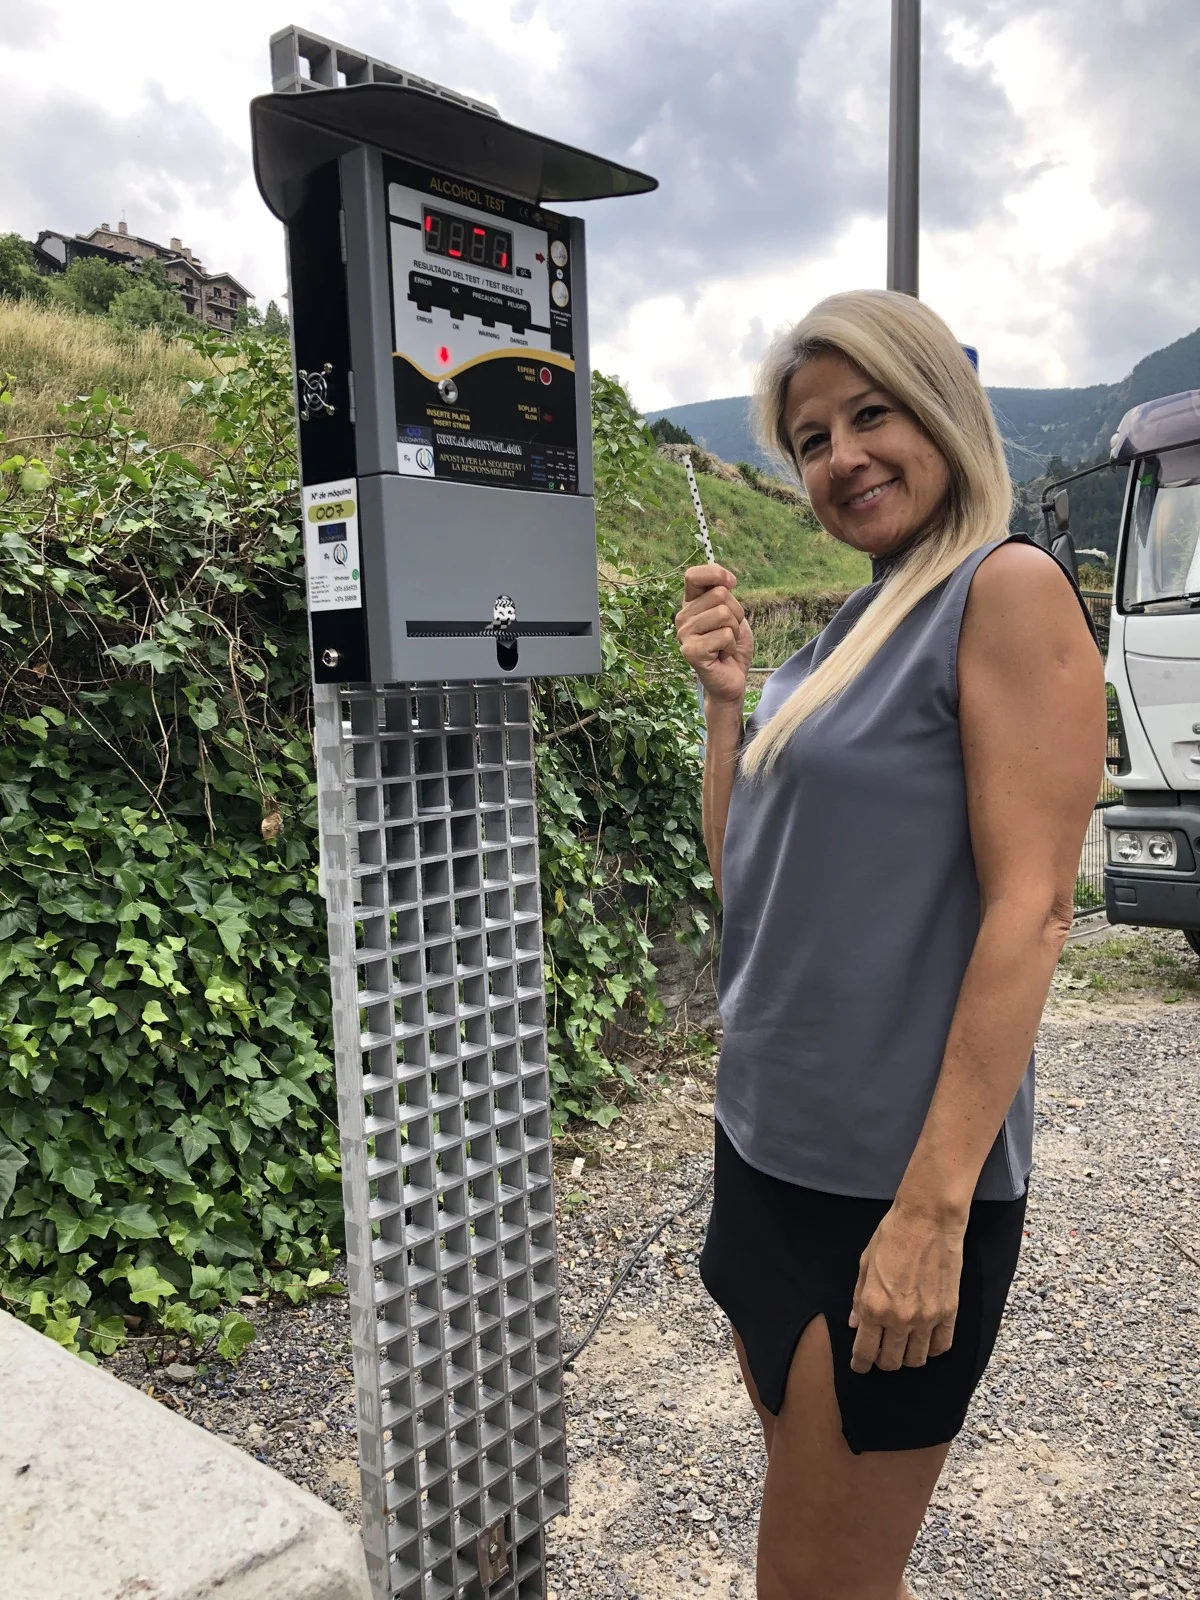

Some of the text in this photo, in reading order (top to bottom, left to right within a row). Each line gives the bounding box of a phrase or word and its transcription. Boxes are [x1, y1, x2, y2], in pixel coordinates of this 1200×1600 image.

[429, 177, 505, 212] ALCOHOL TEST
[413, 260, 452, 277] RESULTADO
[452, 270, 465, 281] DEL
[465, 273, 480, 285] TEST
[486, 279, 501, 290] TEST
[501, 283, 524, 296] RESULT
[414, 276, 432, 287] ERROR
[451, 286, 460, 294] OK
[507, 300, 527, 311] PELIGRO
[416, 315, 433, 324] ERROR
[452, 323, 460, 331] OK
[478, 330, 500, 340] WARNING
[509, 337, 529, 346] DANGER
[517, 365, 536, 375] ESPERE
[517, 404, 538, 413] SOPLAR
[426, 408, 471, 422] INSERTE PAJITA
[524, 413, 538, 421] BLOW
[433, 419, 471, 430] INSERT STRAW
[440, 453, 465, 463] APOSTA
[465, 456, 478, 466] PER
[478, 459, 487, 467] LA
[487, 460, 522, 471] SEGURETAT
[451, 463, 516, 478] LA RESPONSABILITAT
[319, 491, 326, 499] de
[316, 503, 344, 521] 007
